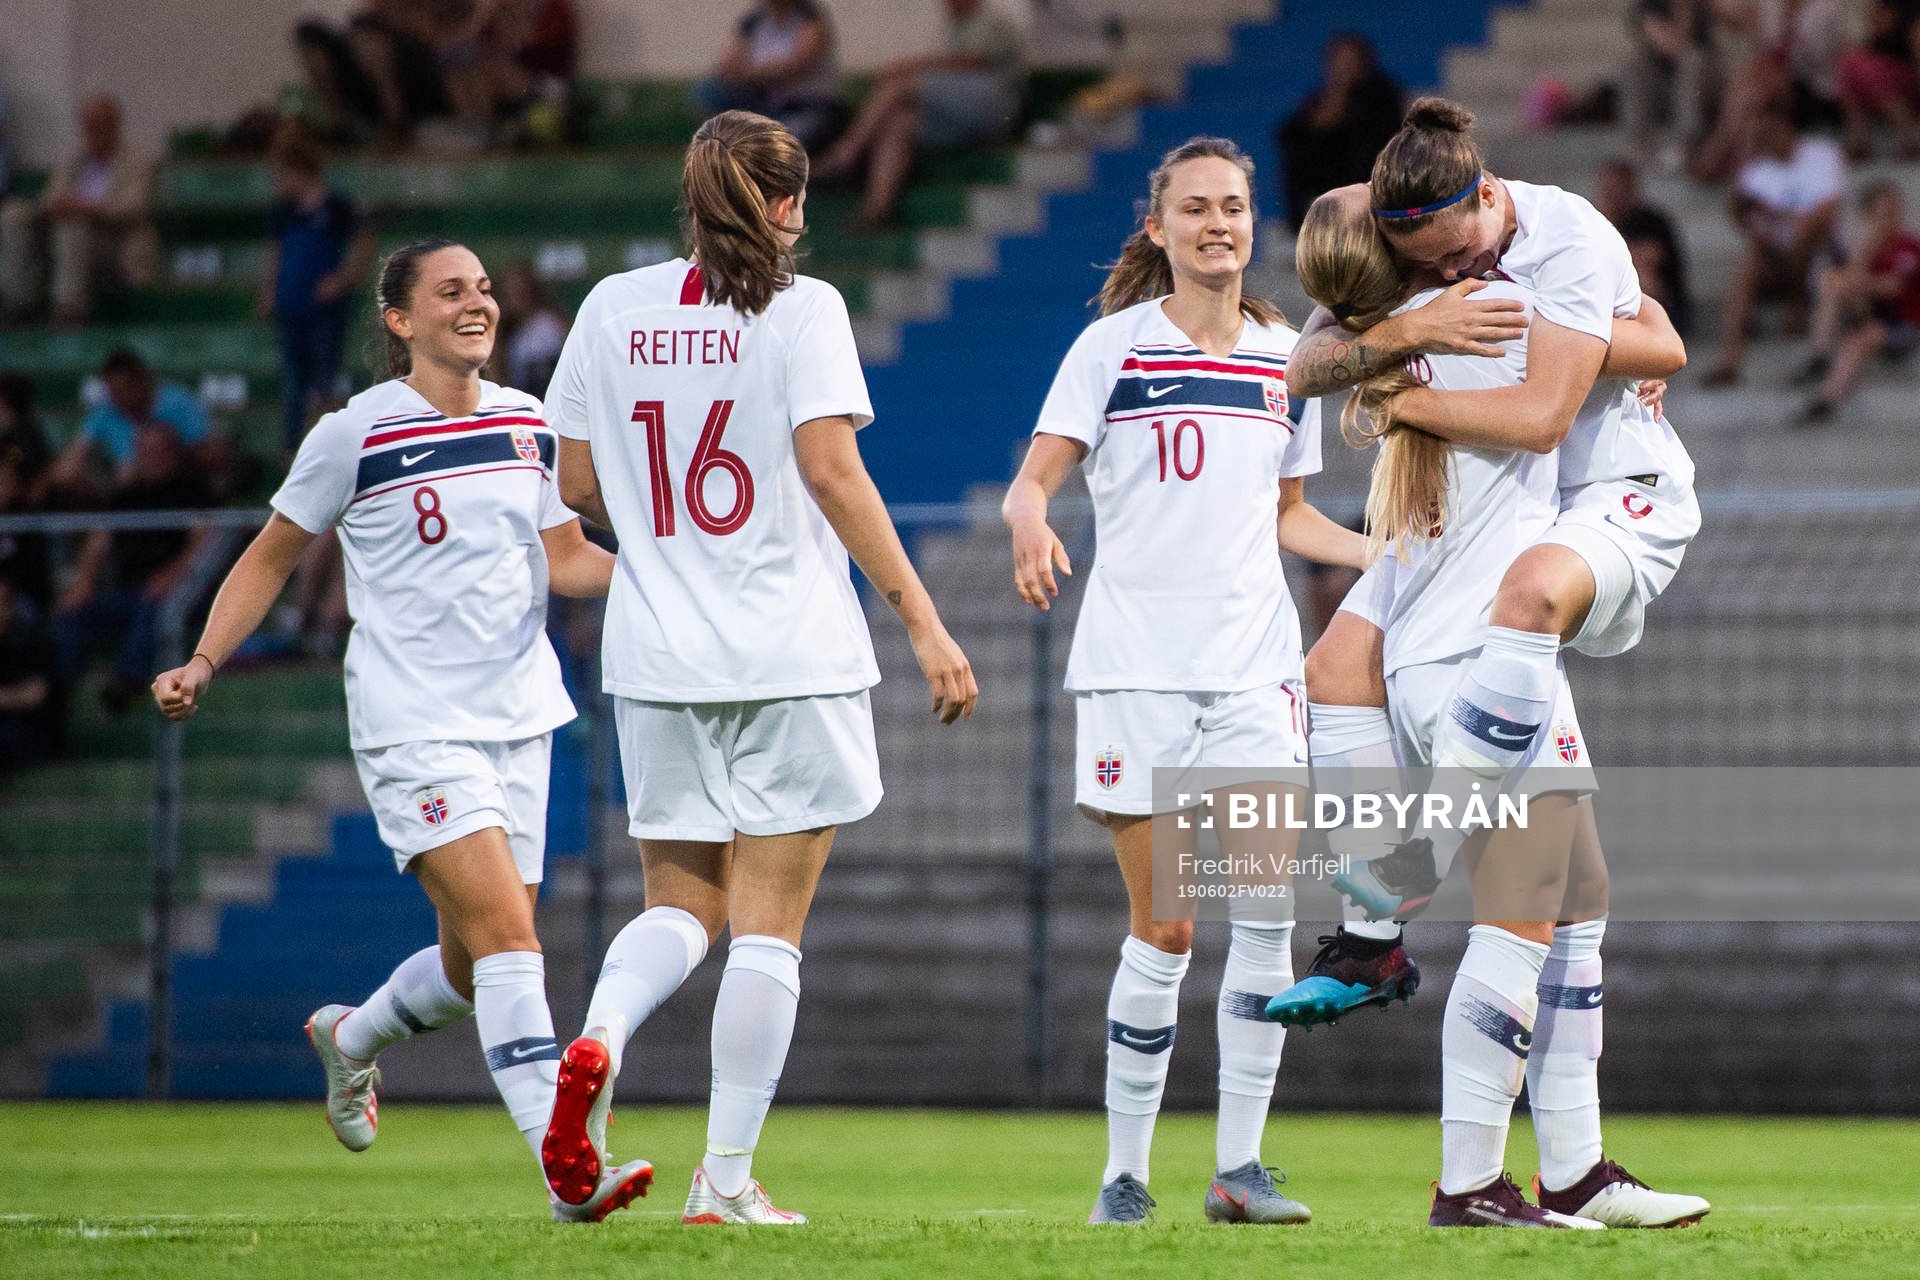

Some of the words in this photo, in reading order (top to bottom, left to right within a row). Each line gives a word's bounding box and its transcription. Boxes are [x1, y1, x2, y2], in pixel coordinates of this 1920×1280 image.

[630, 330, 740, 365] REITEN
[631, 399, 755, 538] 16
[1151, 418, 1205, 482] 10
[413, 486, 448, 545] 8
